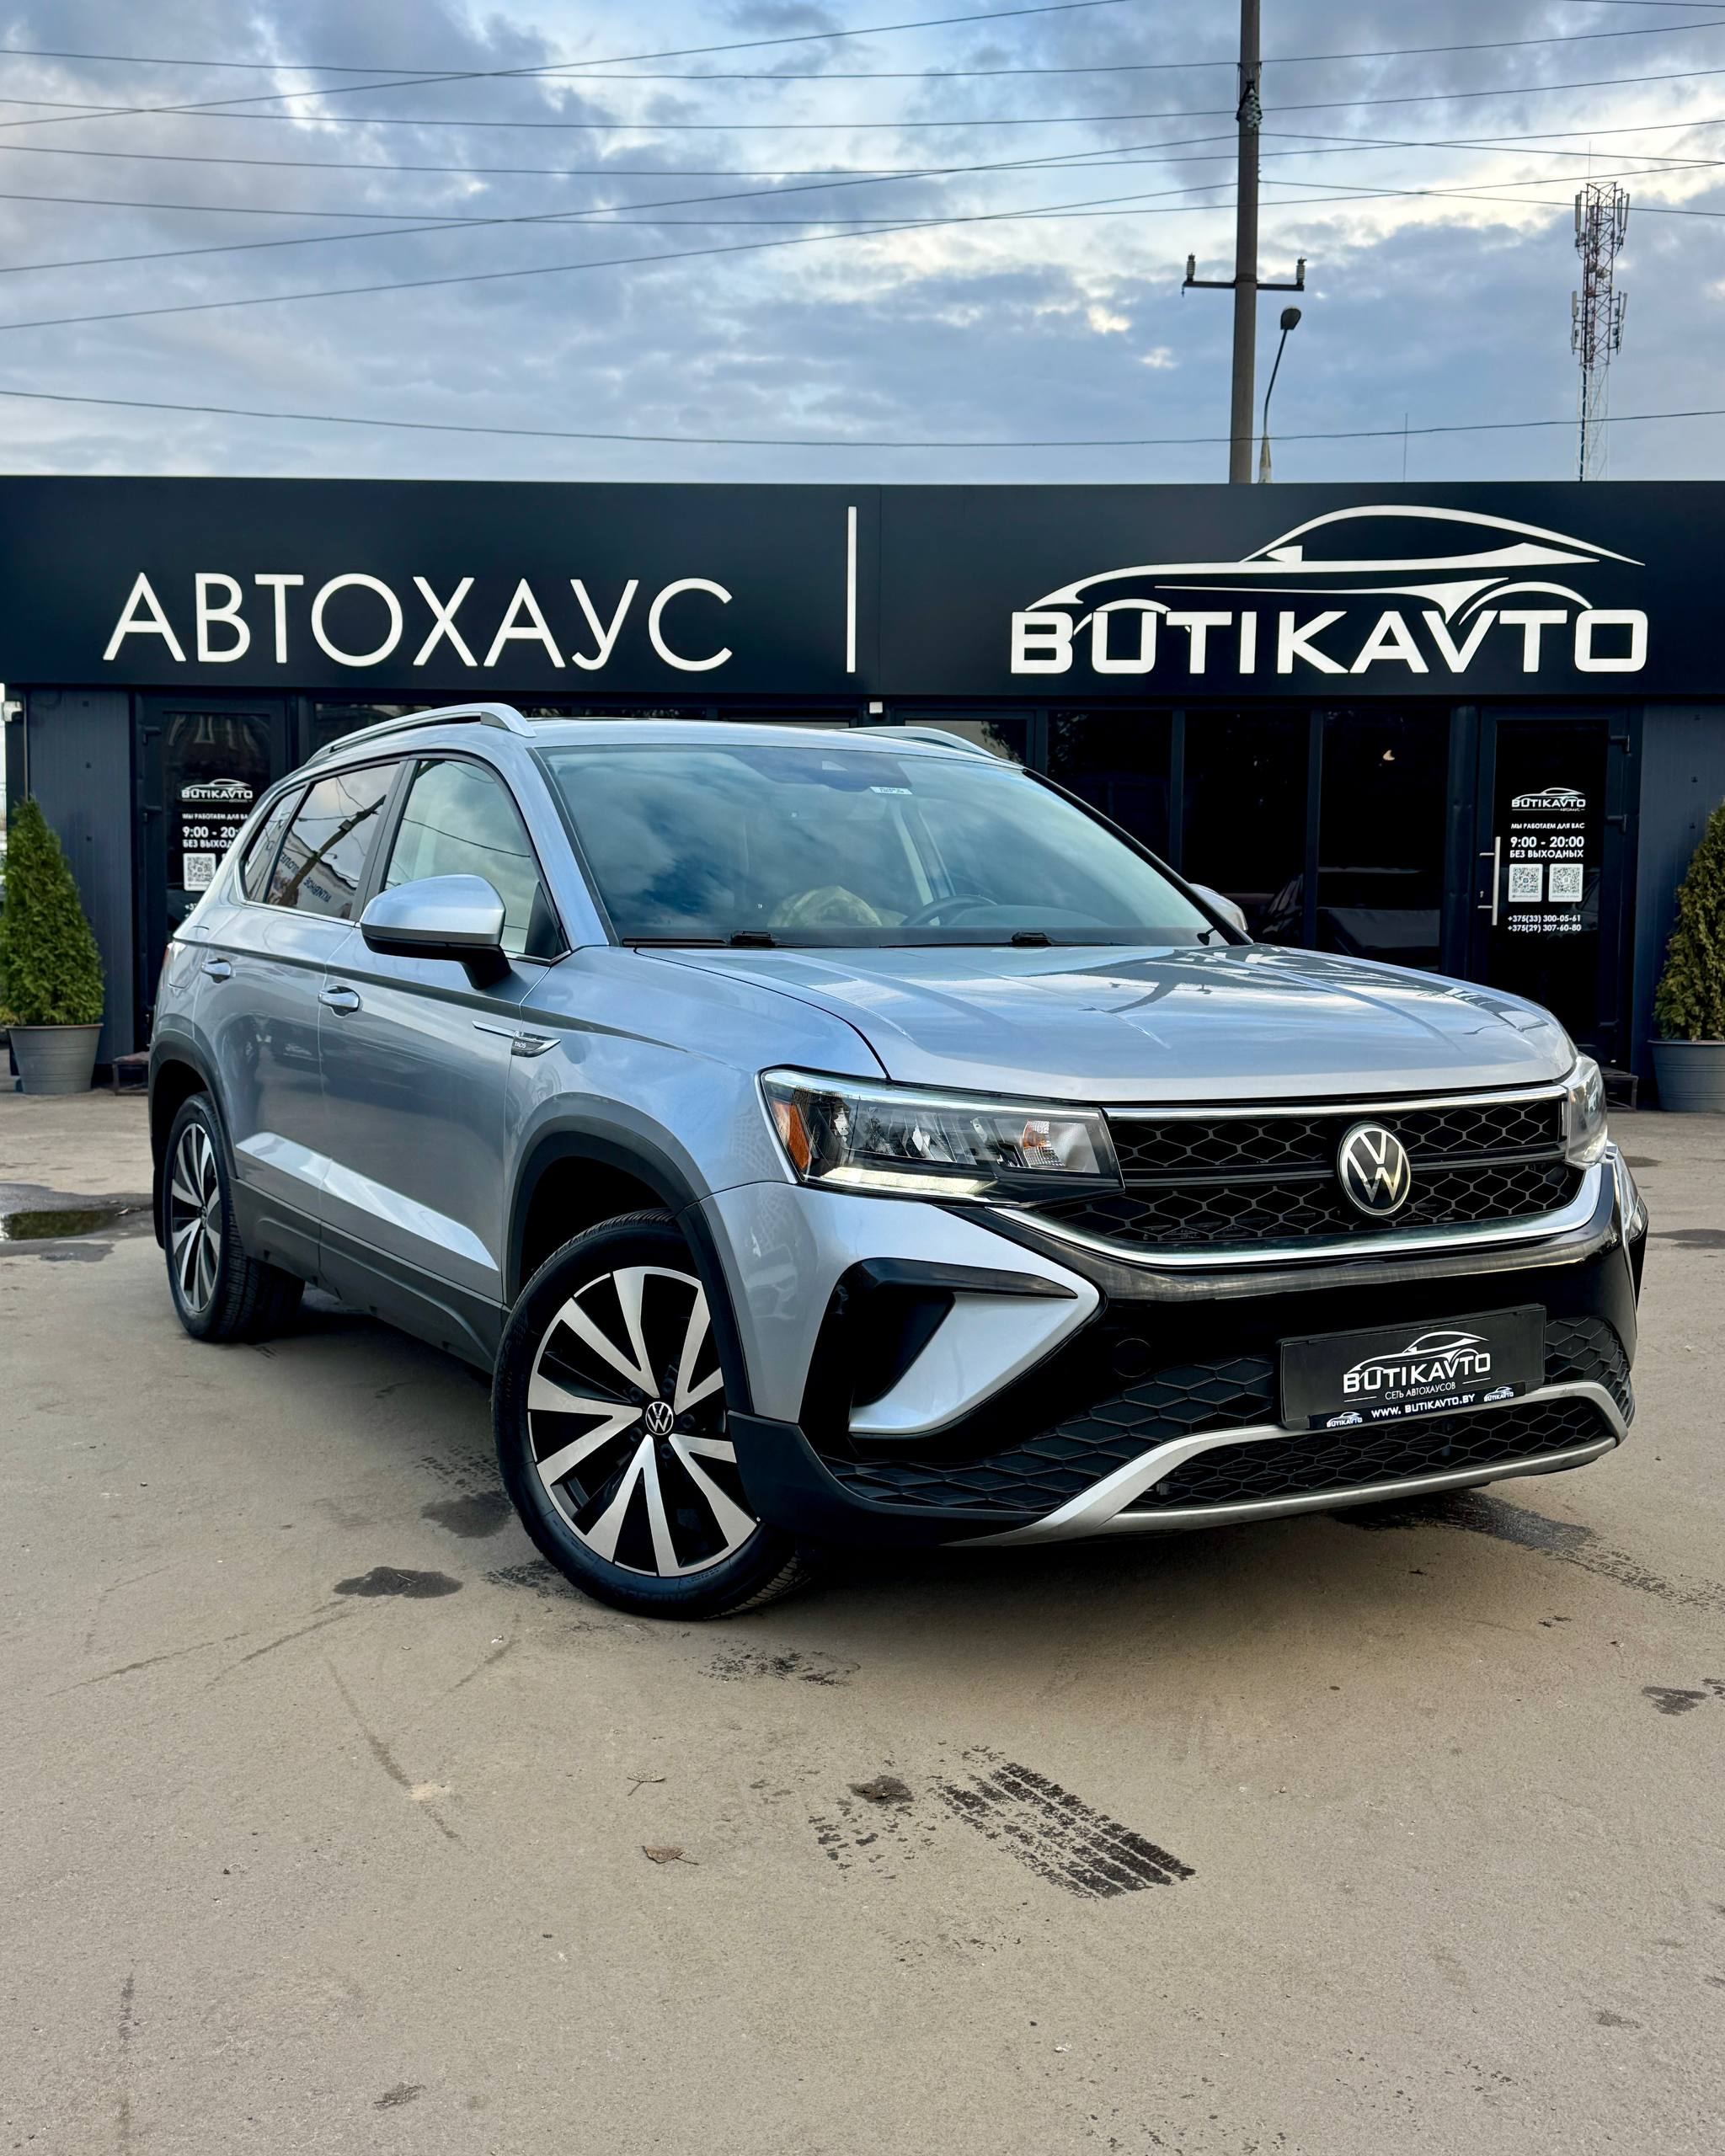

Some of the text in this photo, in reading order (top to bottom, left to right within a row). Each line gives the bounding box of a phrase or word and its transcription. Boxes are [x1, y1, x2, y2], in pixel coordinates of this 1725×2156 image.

[103, 573, 733, 672] АВТОХАУС
[1011, 608, 1648, 675] BUTIKAVTO
[182, 789, 254, 799] BUTIKAVTO
[1512, 798, 1586, 808] BUTIKAVTO
[182, 826, 209, 839] 9:00
[182, 839, 199, 849] БЕЗ
[1510, 836, 1537, 848] 9:00
[1550, 836, 1585, 848] 20:00
[1509, 850, 1584, 859] БЕЗ ВЫХОДНЫХ
[1508, 915, 1581, 924] +375(33) 300-05-61
[1508, 924, 1582, 933] +375(29) 307-60-80
[1343, 1353, 1491, 1394] BUTIKAVTO
[1385, 1381, 1456, 1401] СЕТЬ АВТОХАУСОВ
[1404, 1393, 1476, 1413] BUTIKAVTO.BY
